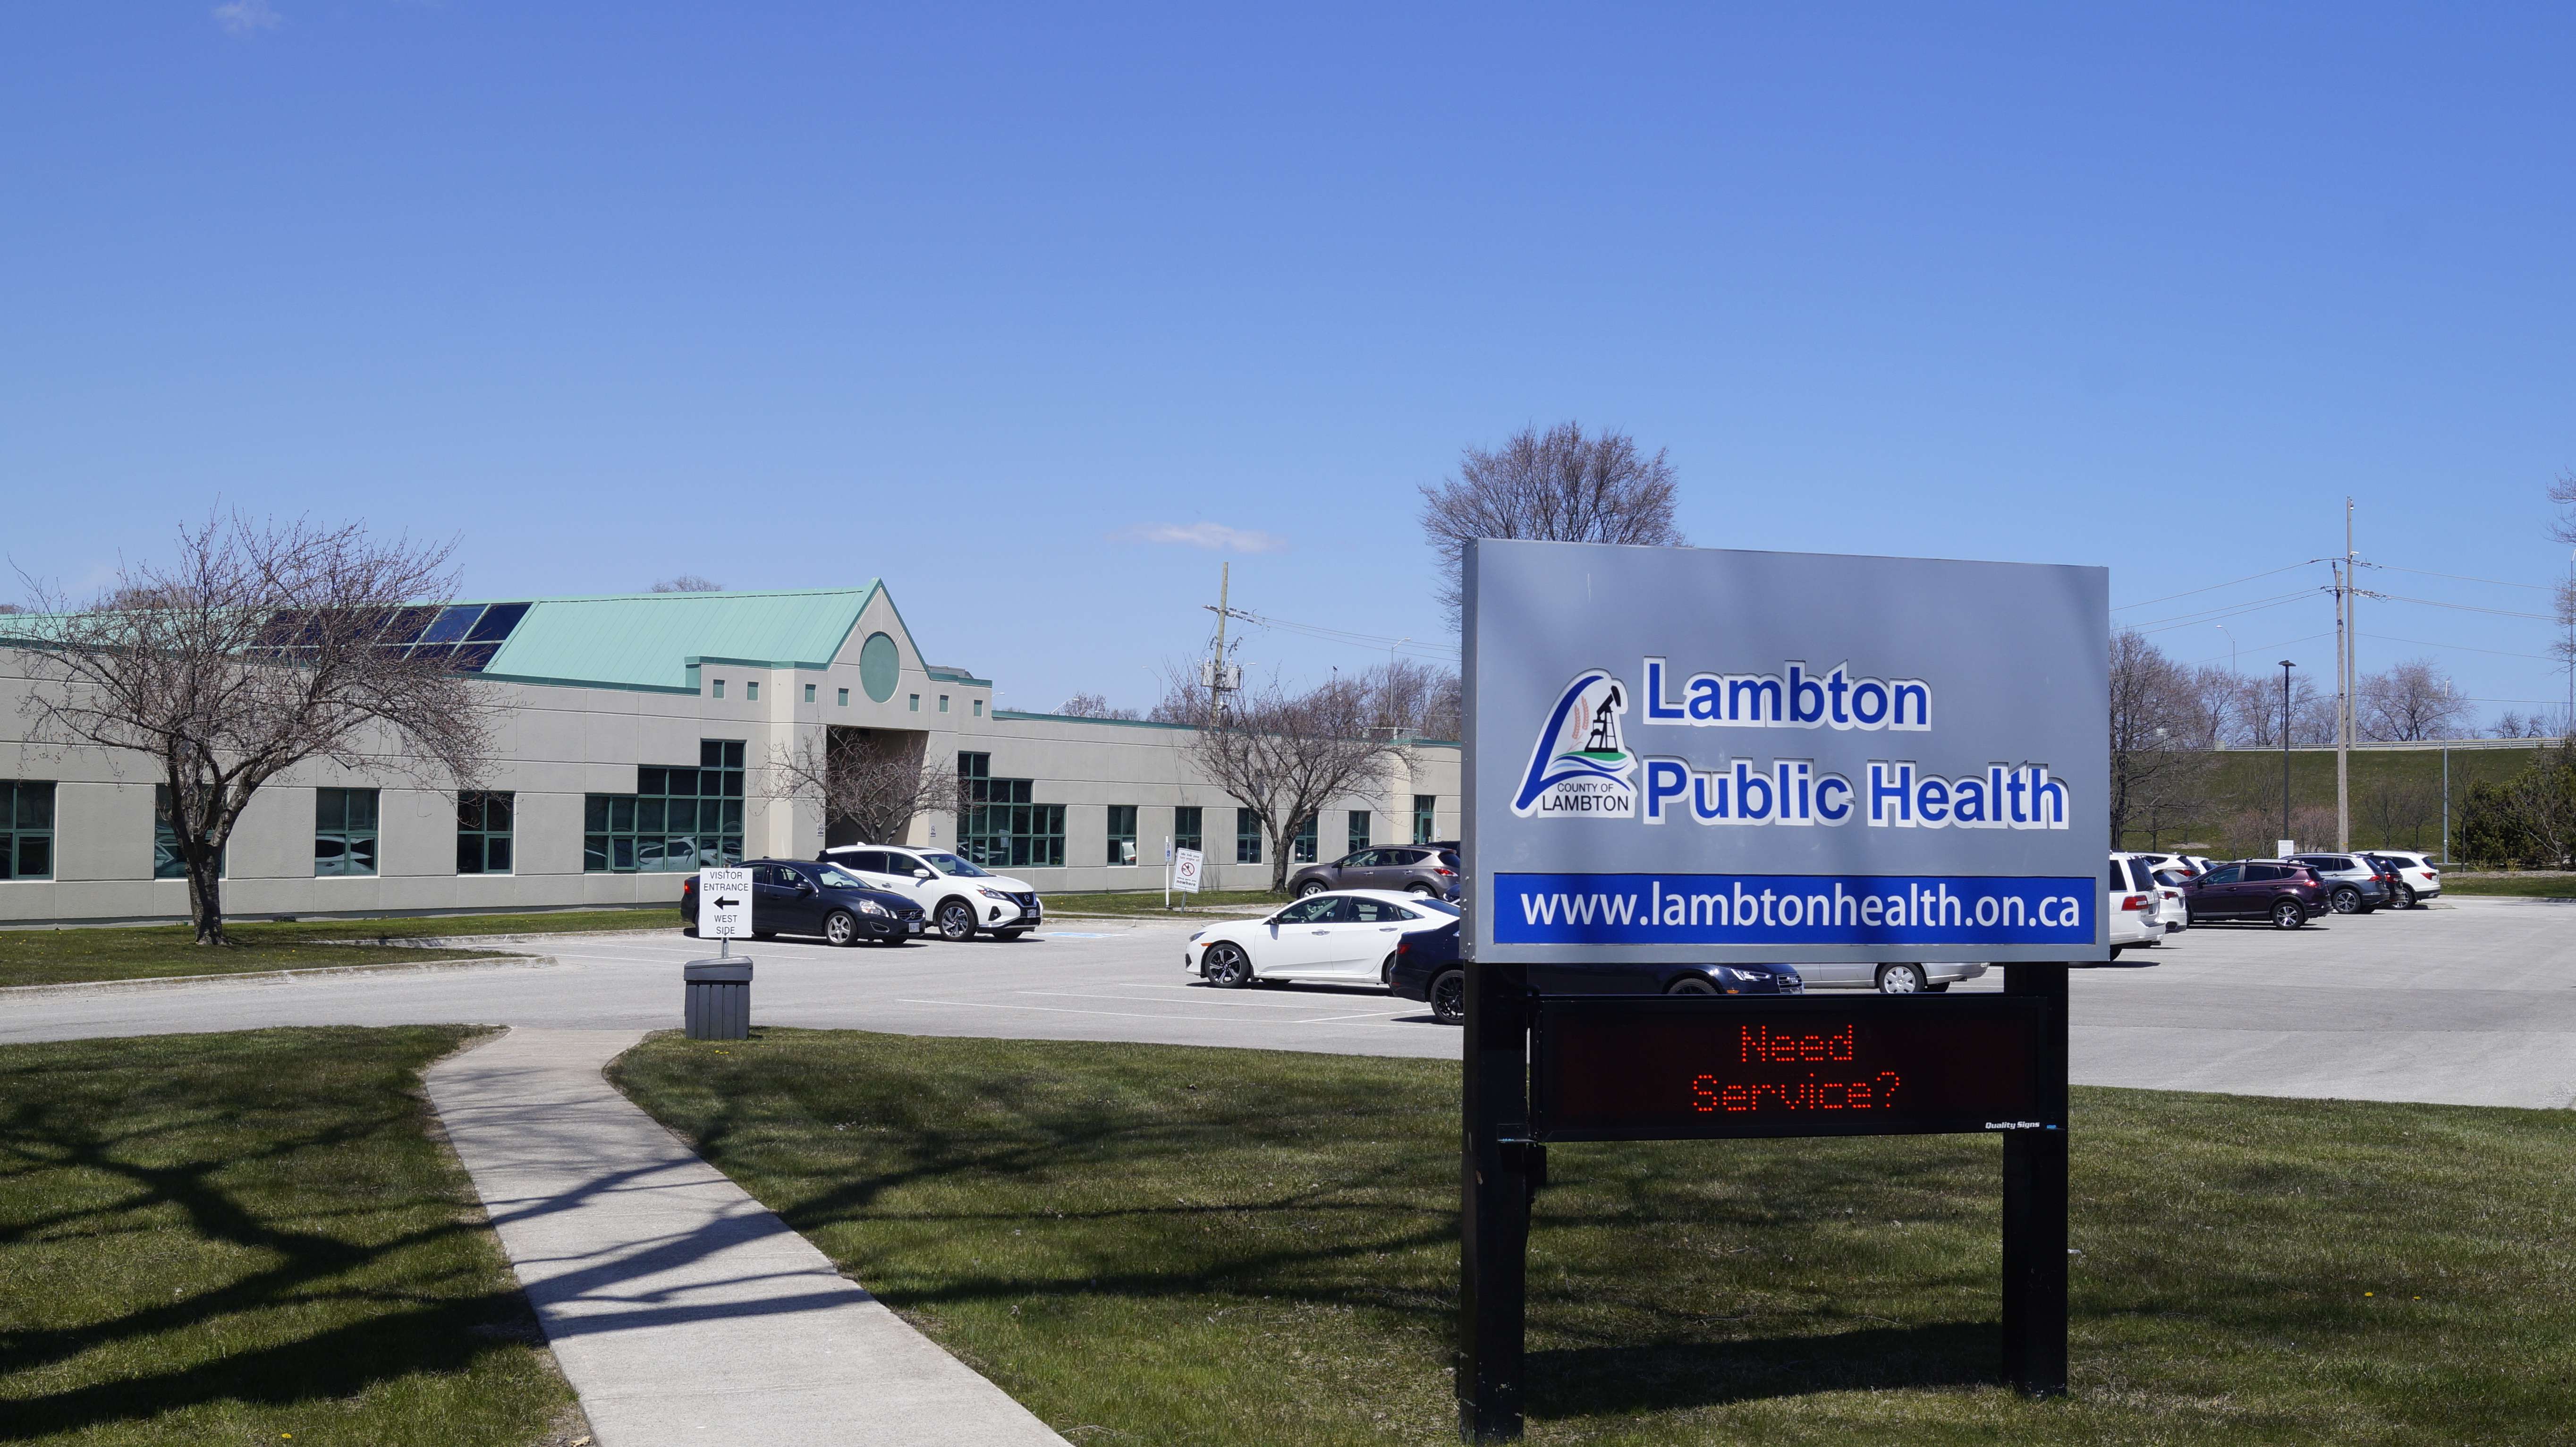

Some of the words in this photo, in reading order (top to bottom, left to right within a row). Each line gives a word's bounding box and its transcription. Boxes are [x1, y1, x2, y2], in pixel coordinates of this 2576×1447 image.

[1649, 663, 1927, 725] Lambton
[1558, 783, 1597, 792] COUNTY
[1601, 783, 1614, 792] OF
[1648, 761, 1849, 820] Public
[1872, 763, 2063, 822] Health
[1542, 795, 1628, 811] LAMBTON
[710, 871, 742, 879] VISITOR
[703, 883, 748, 891] ENTRANCE
[1521, 881, 2079, 927] www.lambtonhealth.on.ca
[714, 915, 737, 923] WEST
[716, 926, 735, 934] SIDE
[1742, 1025, 1853, 1062] Need
[1693, 1071, 1900, 1112] Service?
